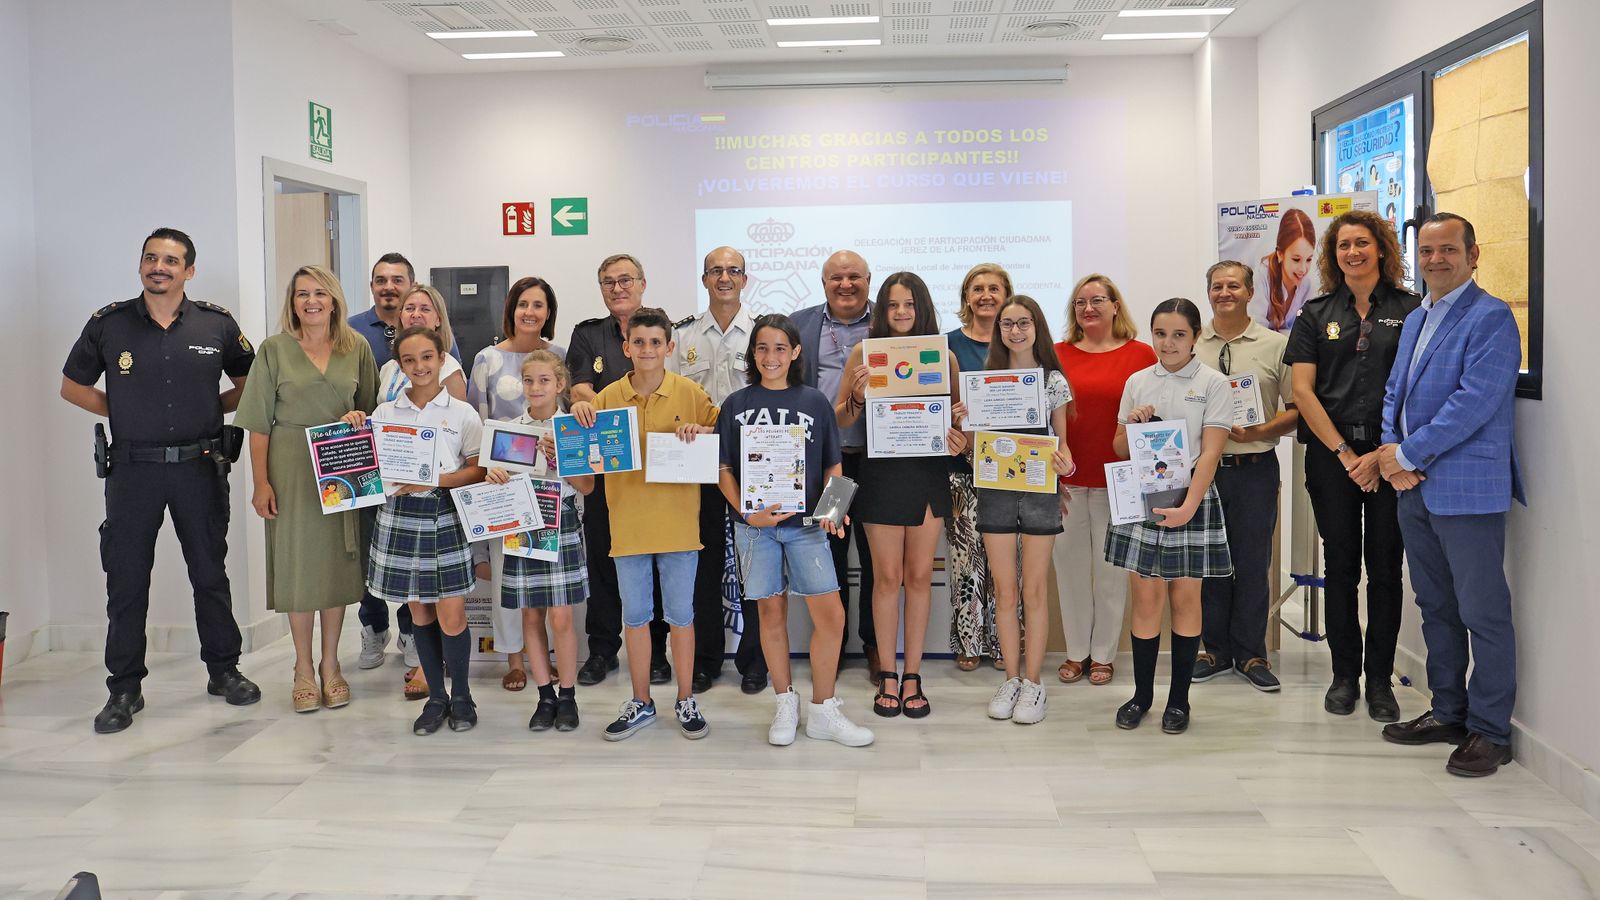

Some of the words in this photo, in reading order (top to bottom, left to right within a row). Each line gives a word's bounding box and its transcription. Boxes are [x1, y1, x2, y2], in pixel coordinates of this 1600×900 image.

[715, 134, 812, 150] !!MUCHAS
[819, 131, 908, 148] GRACIAS
[915, 130, 929, 145] A
[934, 128, 1003, 145] TODOS
[1009, 127, 1049, 143] LOS
[1353, 121, 1401, 158] SEGURIDAD?
[312, 146, 331, 157] SALIDA
[745, 154, 840, 171] CENTROS
[847, 150, 1019, 168] PARTICIPANTES!!
[698, 175, 840, 196] ¡VOLVEREMOS
[847, 175, 870, 188] EL
[876, 172, 946, 188] CURSO
[953, 171, 996, 187] QUE
[1002, 169, 1068, 185] VIENE!
[854, 237, 912, 246] DELEGACIÓN
[914, 237, 927, 246] DE
[928, 235, 997, 245] PARTICIPACIÓN
[999, 235, 1052, 243] CIUDADANA
[900, 246, 928, 254] JEREZ
[944, 245, 956, 253] LA
[957, 244, 1006, 253] FRONTERA
[916, 263, 937, 271] Local
[939, 263, 950, 271] de
